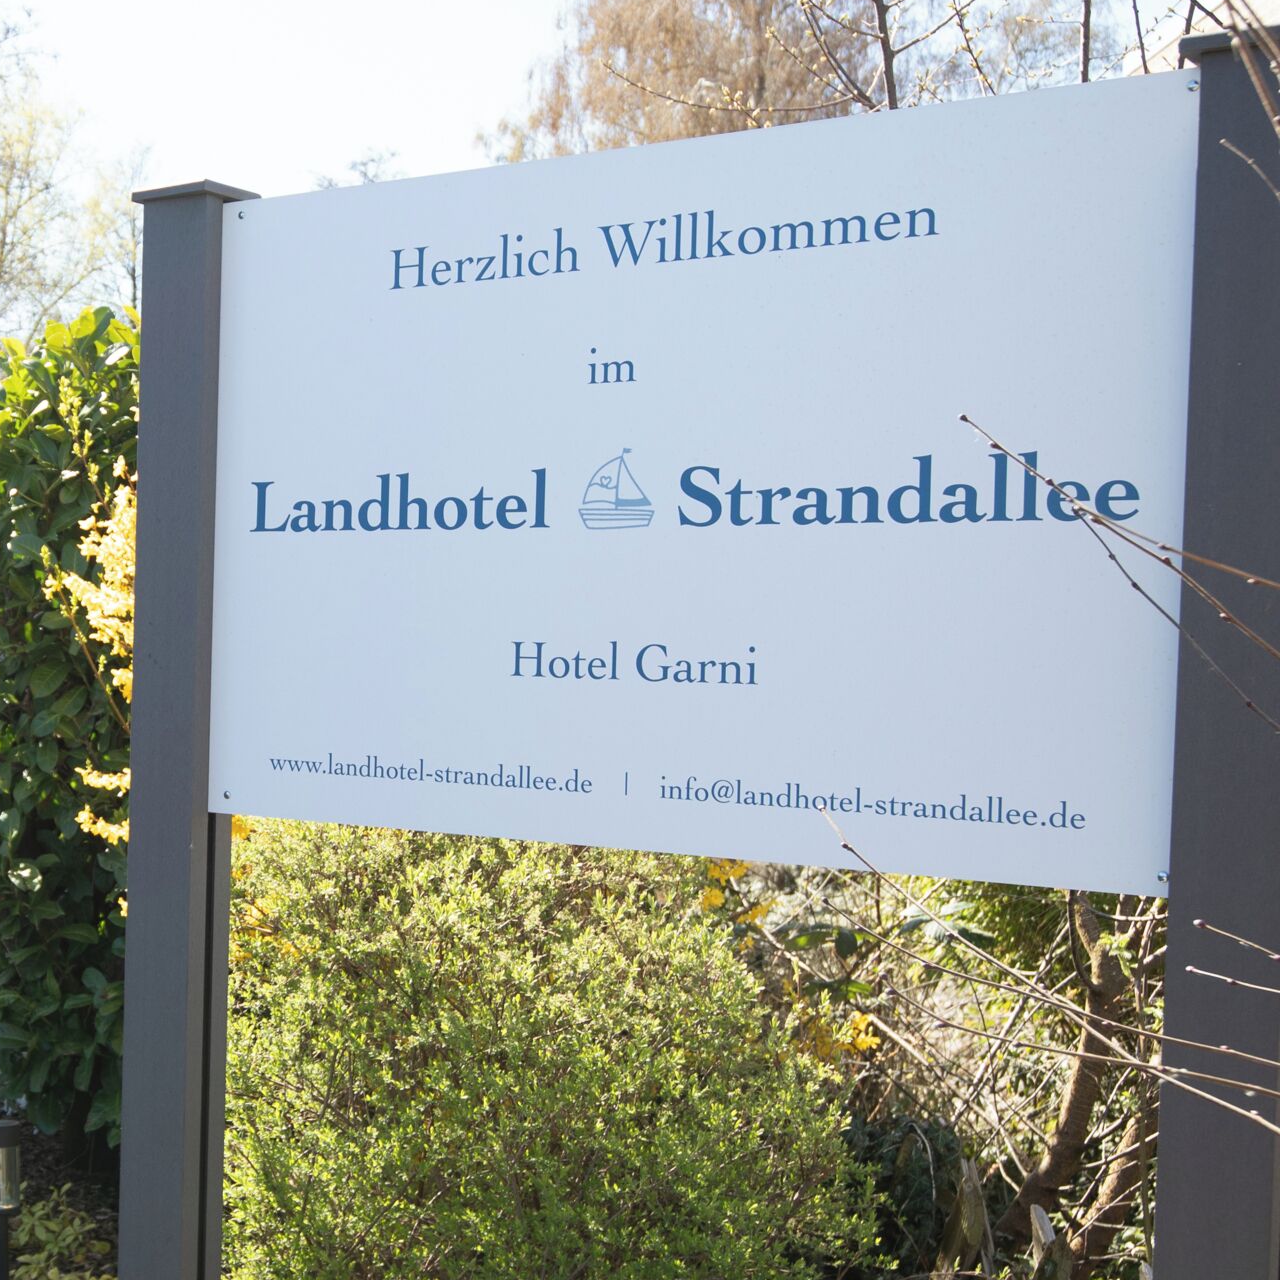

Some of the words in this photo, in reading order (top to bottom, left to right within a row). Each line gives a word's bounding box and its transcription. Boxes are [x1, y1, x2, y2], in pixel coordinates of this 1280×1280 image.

[389, 226, 581, 291] Herzlich
[596, 207, 940, 269] Willkommen
[587, 346, 638, 385] im
[248, 467, 551, 533] Landhotel
[677, 450, 1141, 528] Strandallee
[510, 640, 620, 681] Hotel
[635, 643, 759, 686] Garni
[269, 752, 594, 794] www.landhotel-strandallee.de
[659, 775, 1087, 830] info@landhotel-strandallee.de
